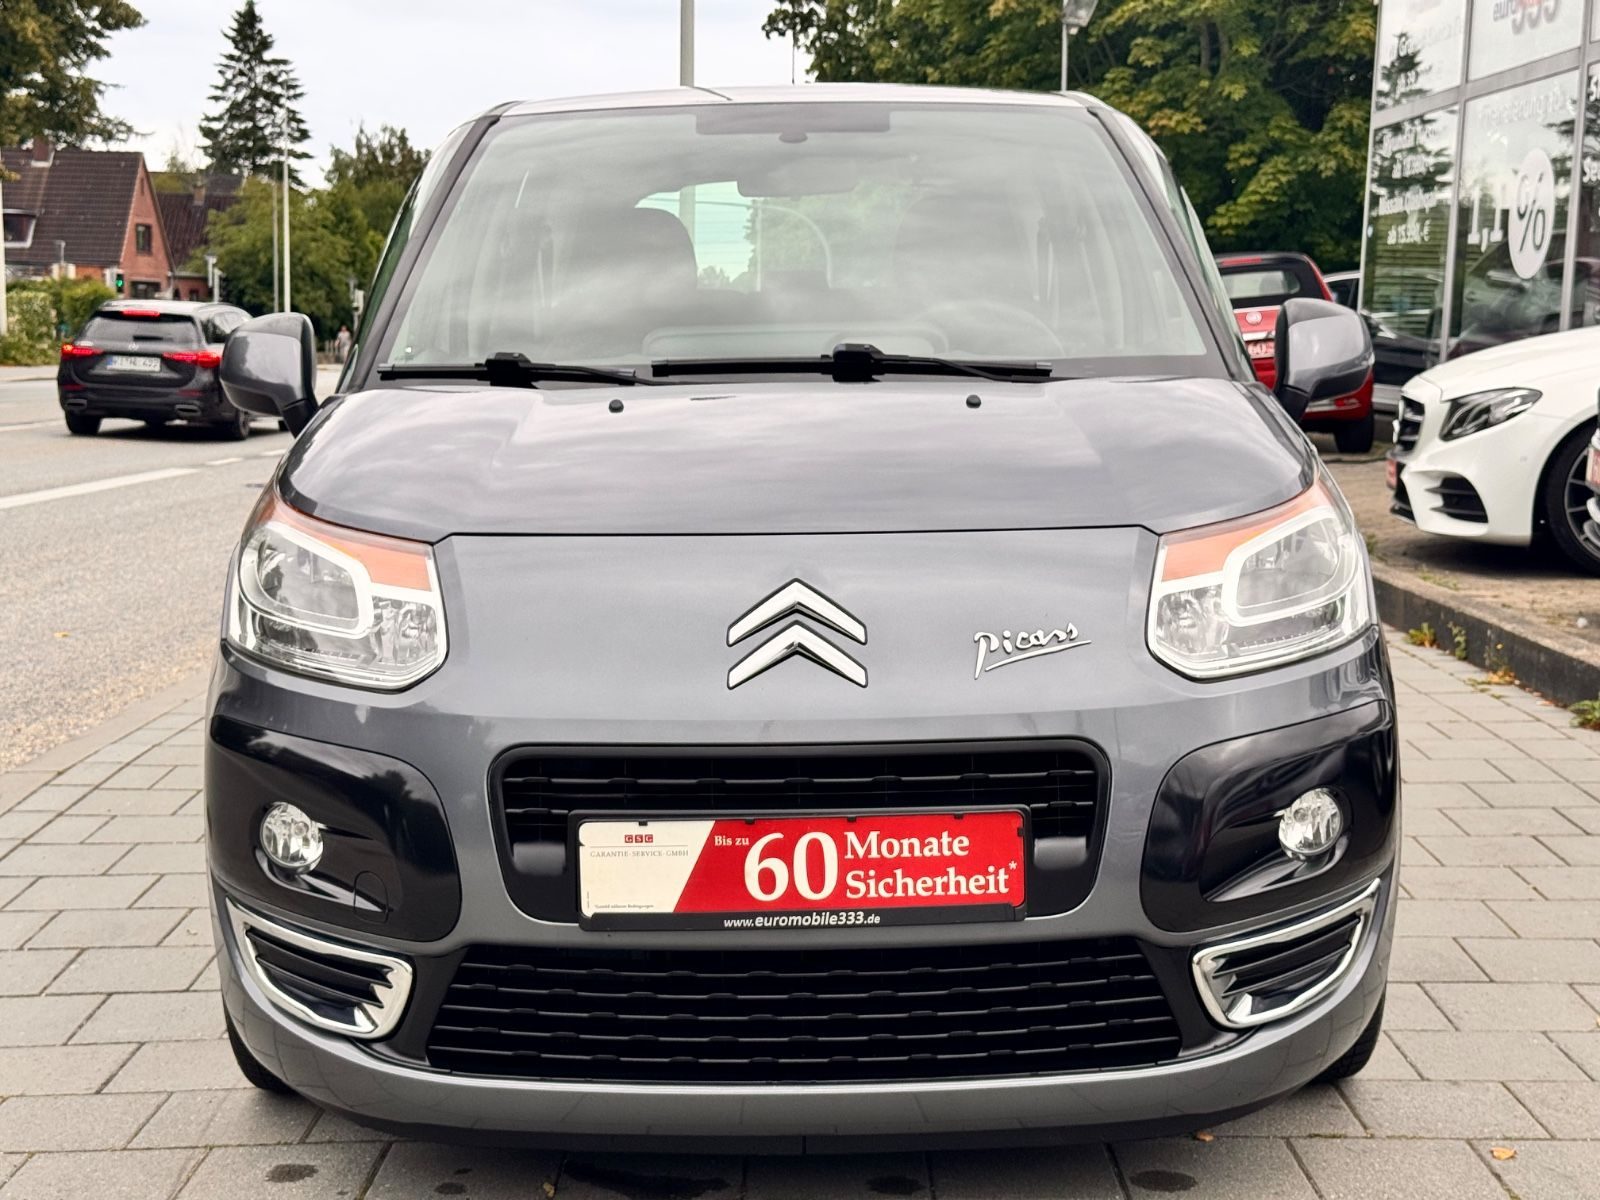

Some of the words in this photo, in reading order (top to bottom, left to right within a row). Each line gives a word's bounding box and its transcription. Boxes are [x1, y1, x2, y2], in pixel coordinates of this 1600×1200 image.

[844, 830, 970, 859] Monate
[714, 835, 733, 846] Bis
[735, 836, 750, 846] zu
[744, 831, 839, 902] 60
[723, 911, 881, 929] www.euromobile333.de
